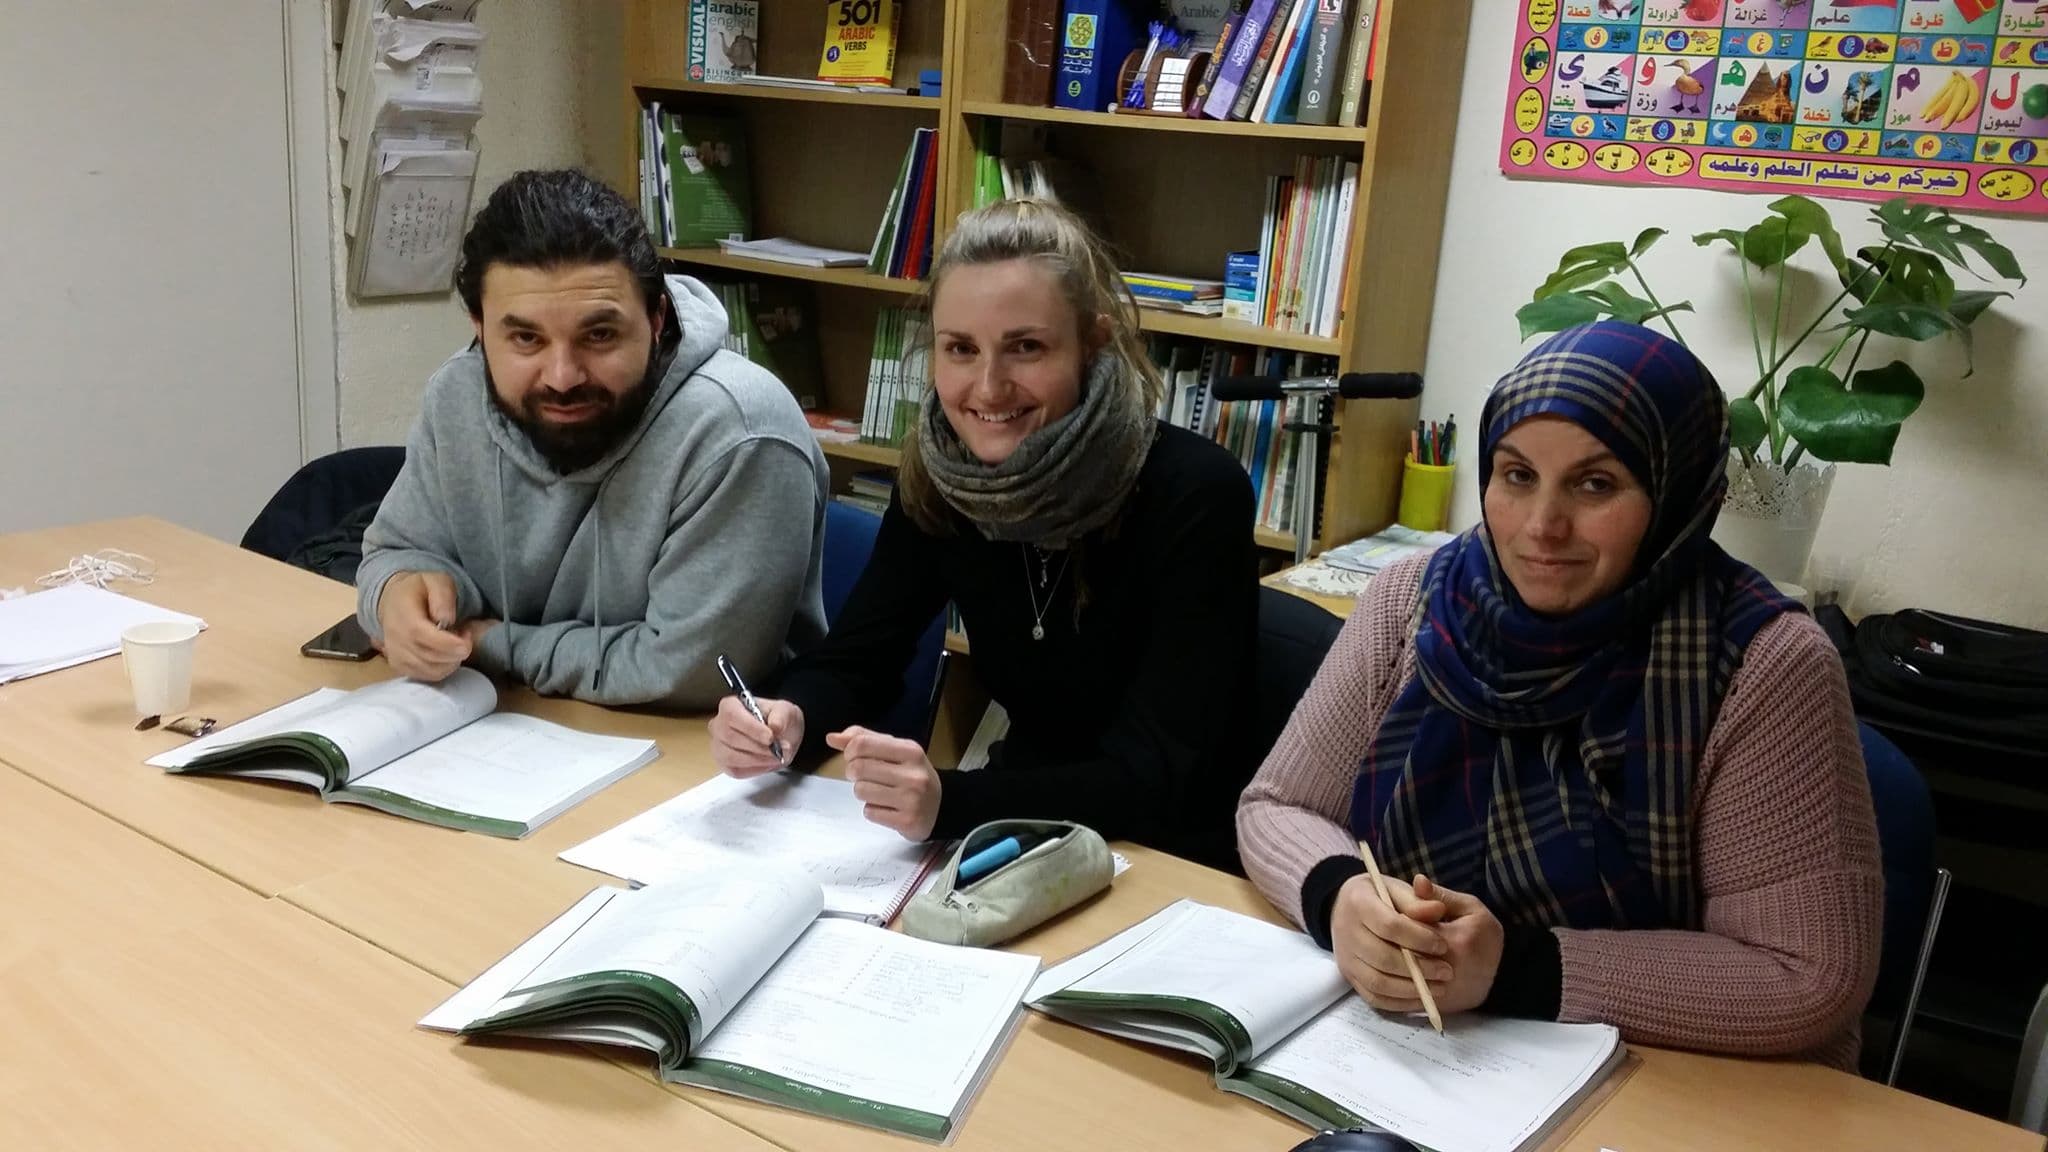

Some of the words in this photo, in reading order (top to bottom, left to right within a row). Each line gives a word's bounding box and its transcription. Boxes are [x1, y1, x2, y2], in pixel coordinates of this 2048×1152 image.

[709, 2, 756, 16] arabic
[838, 0, 881, 26] 501
[1647, 7, 1679, 22] فراولة
[1734, 8, 1768, 25] غزالة
[1909, 12, 1945, 31] ظرف
[2003, 14, 2046, 33] طيارة
[691, 4, 705, 64] VISUAL
[838, 26, 876, 40] ARABIC
[844, 41, 868, 51] VERBS
[1936, 41, 1953, 58] ظ
[1637, 57, 1657, 86] و
[1804, 63, 1829, 94] ن
[1896, 67, 1920, 101] م
[1991, 71, 2020, 110] ل
[1552, 94, 1576, 111] يخت
[1636, 93, 1658, 112] وزة
[1714, 102, 1737, 115] هرم
[1803, 106, 1831, 122] نخلة
[1889, 108, 1912, 126] موز
[1983, 115, 2023, 132] ليمون
[1708, 157, 1760, 177] وعلمه
[1764, 161, 1811, 179] العلم
[1815, 164, 1859, 184] تعلم
[1863, 170, 1892, 186] من
[1898, 168, 1959, 190] خيركم
